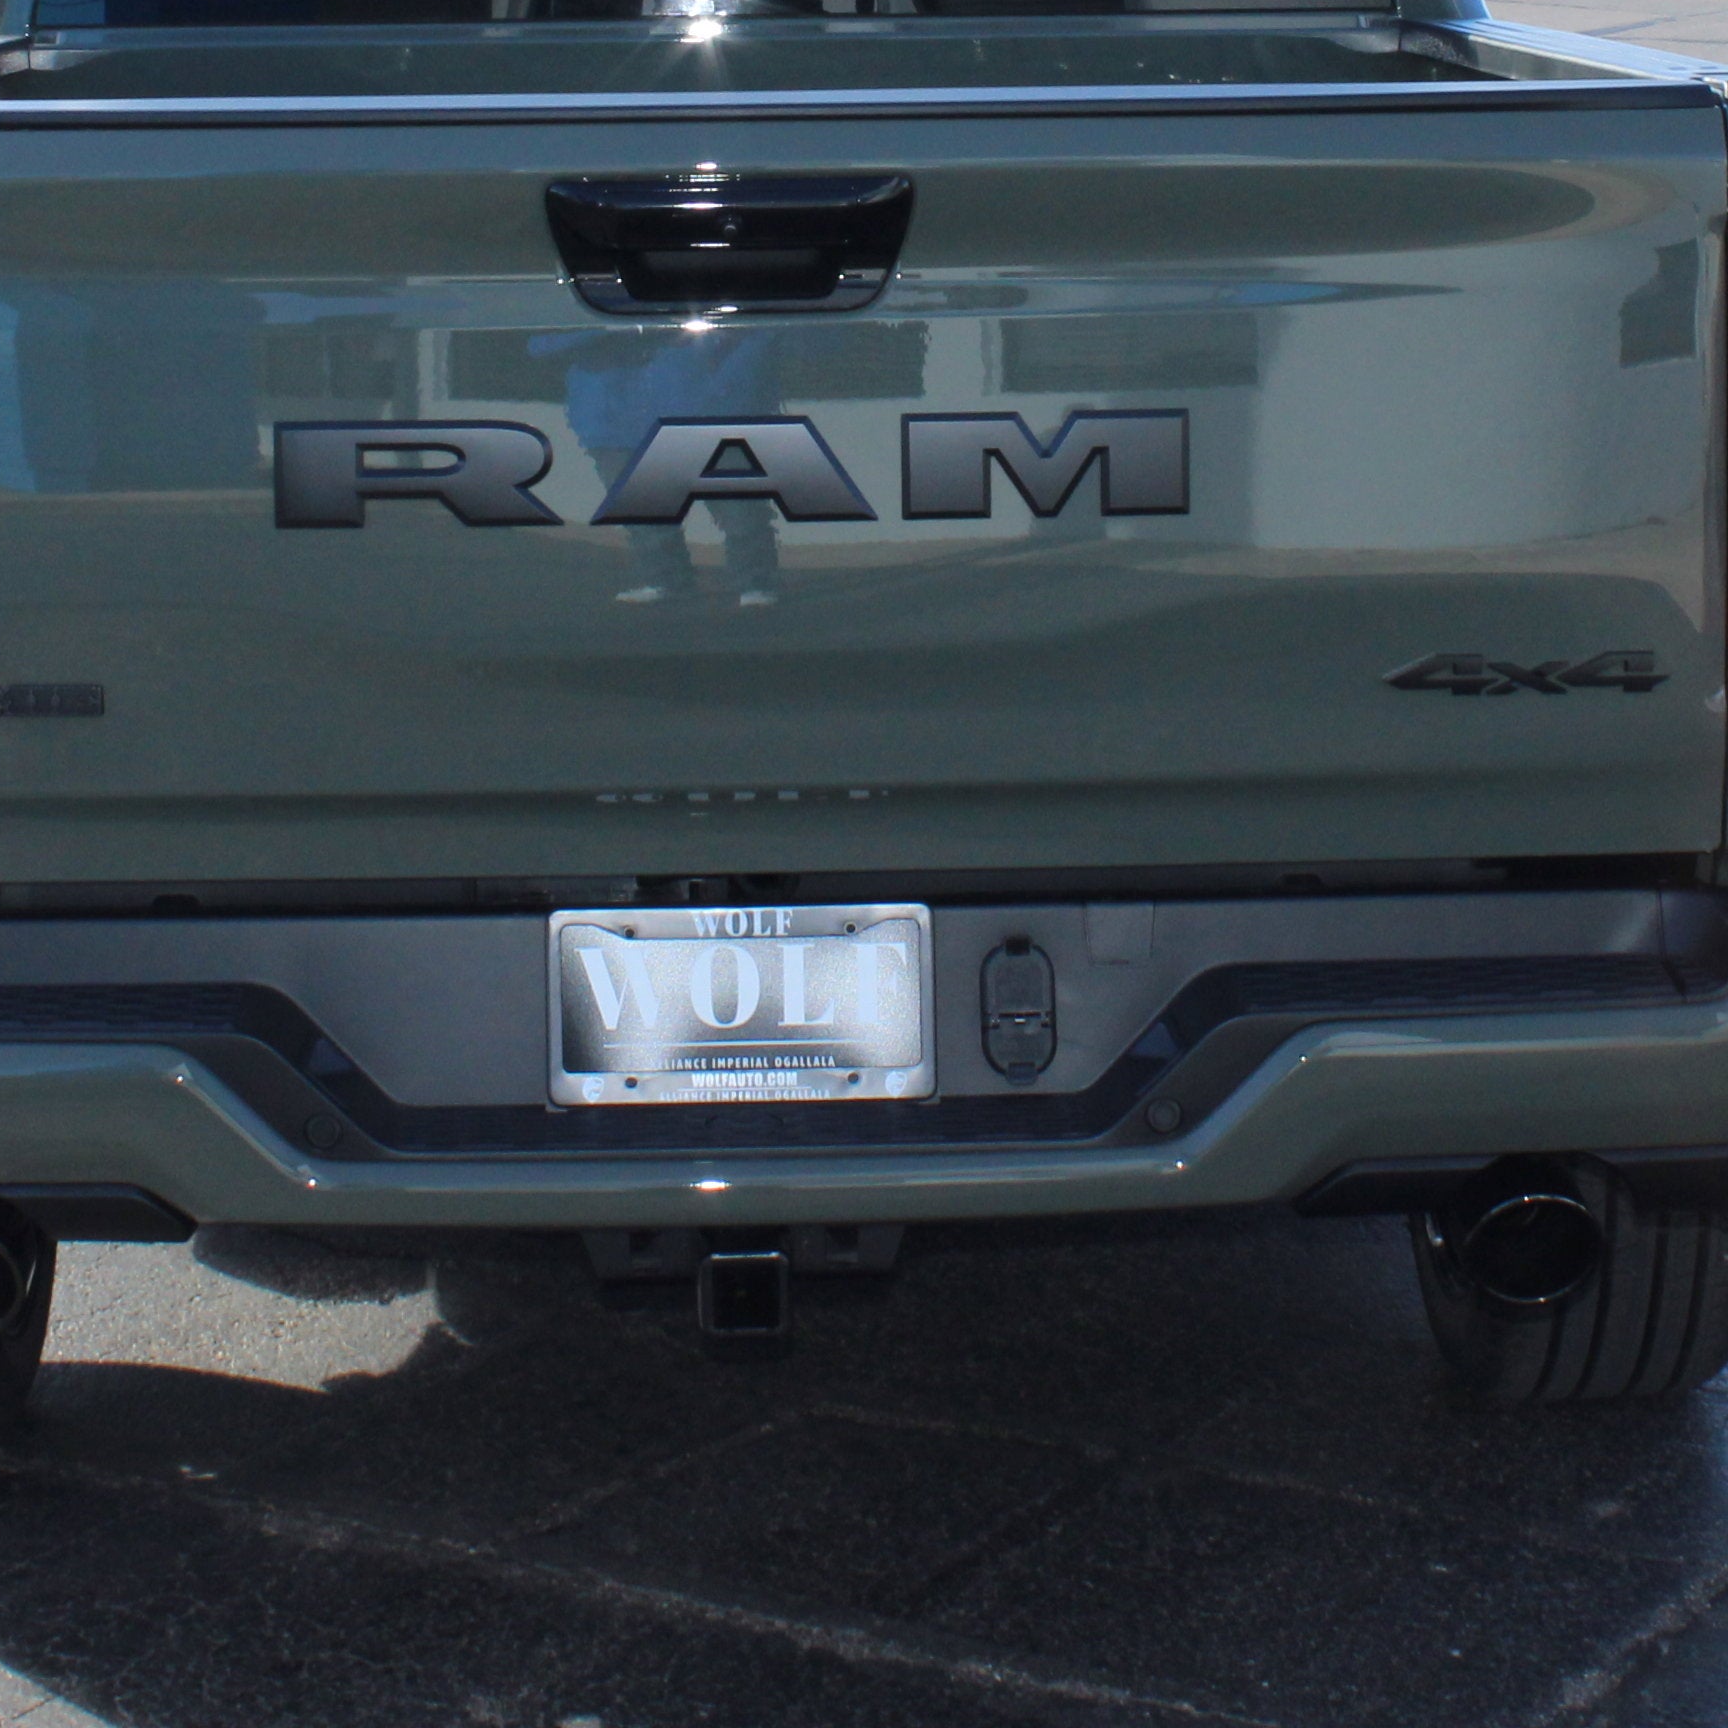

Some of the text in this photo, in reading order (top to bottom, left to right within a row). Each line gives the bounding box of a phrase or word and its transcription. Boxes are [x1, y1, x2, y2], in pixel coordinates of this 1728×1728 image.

[272, 407, 1191, 530] RAM
[692, 909, 794, 938] WOLF
[574, 941, 908, 1032] WOLF
[649, 1055, 836, 1071] LLIANCE IMPERIAL OGALLALA
[691, 1071, 798, 1088] WOLFAUTO.COM
[716, 1089, 769, 1102] IMPERIAL
